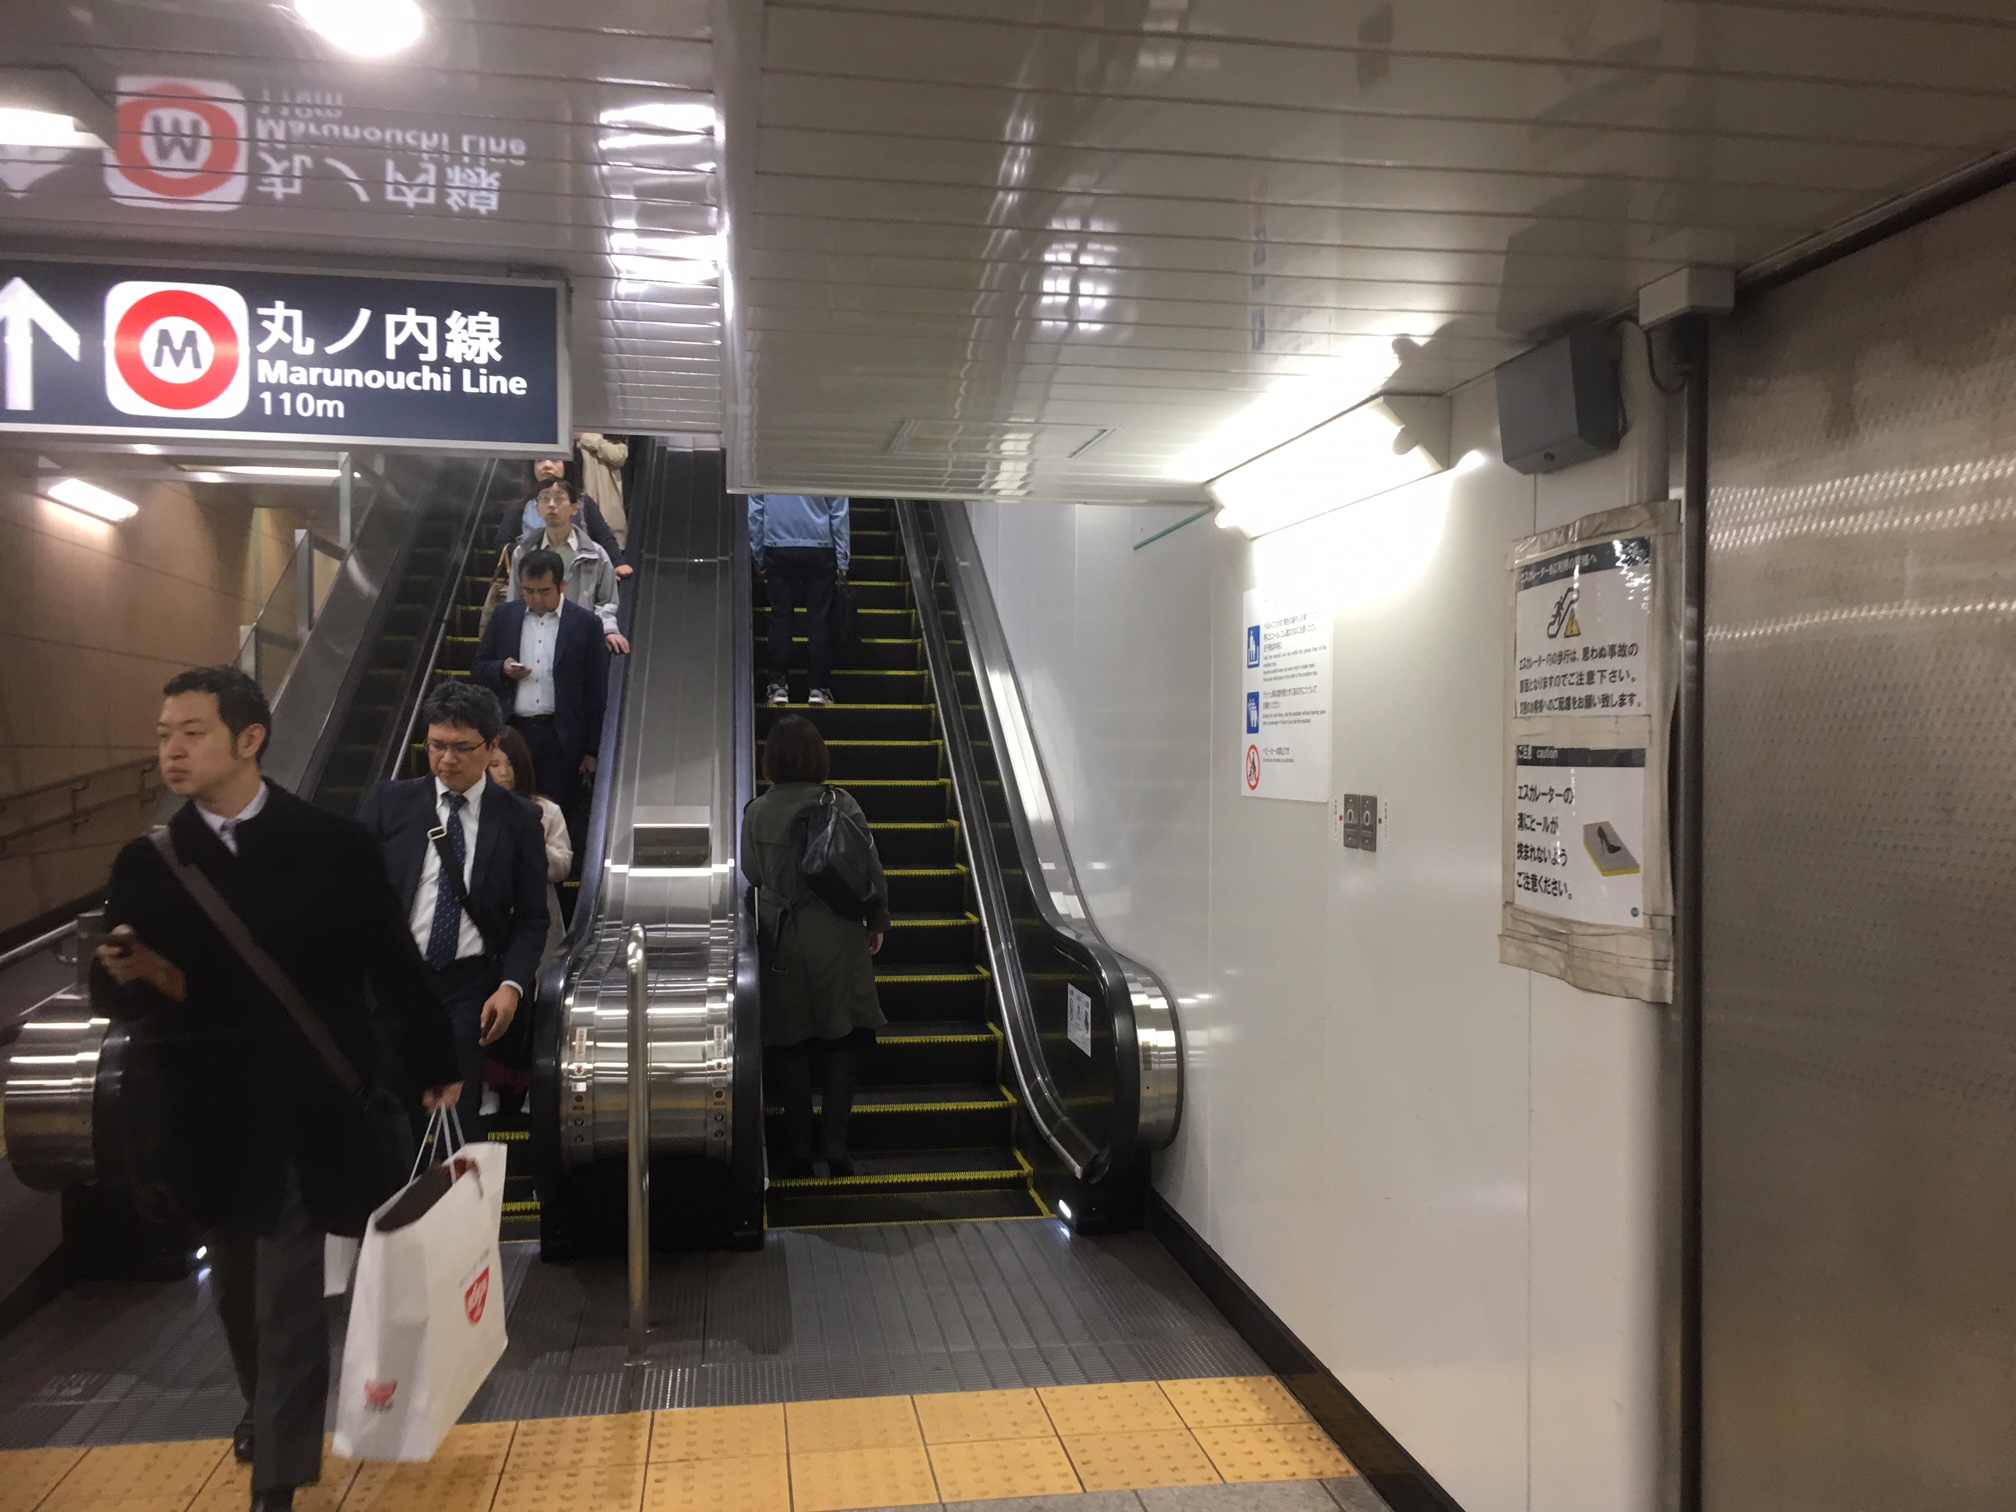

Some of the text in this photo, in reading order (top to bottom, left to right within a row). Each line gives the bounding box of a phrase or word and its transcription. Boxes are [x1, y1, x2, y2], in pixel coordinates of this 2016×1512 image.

[153, 328, 203, 370] M
[256, 300, 503, 365] 丸ノ内線
[257, 359, 528, 396] Marunouchi Line
[259, 391, 345, 418] 110m
[1517, 784, 1574, 805] エスカレーターの
[1516, 871, 1573, 900] ご注意ください。
